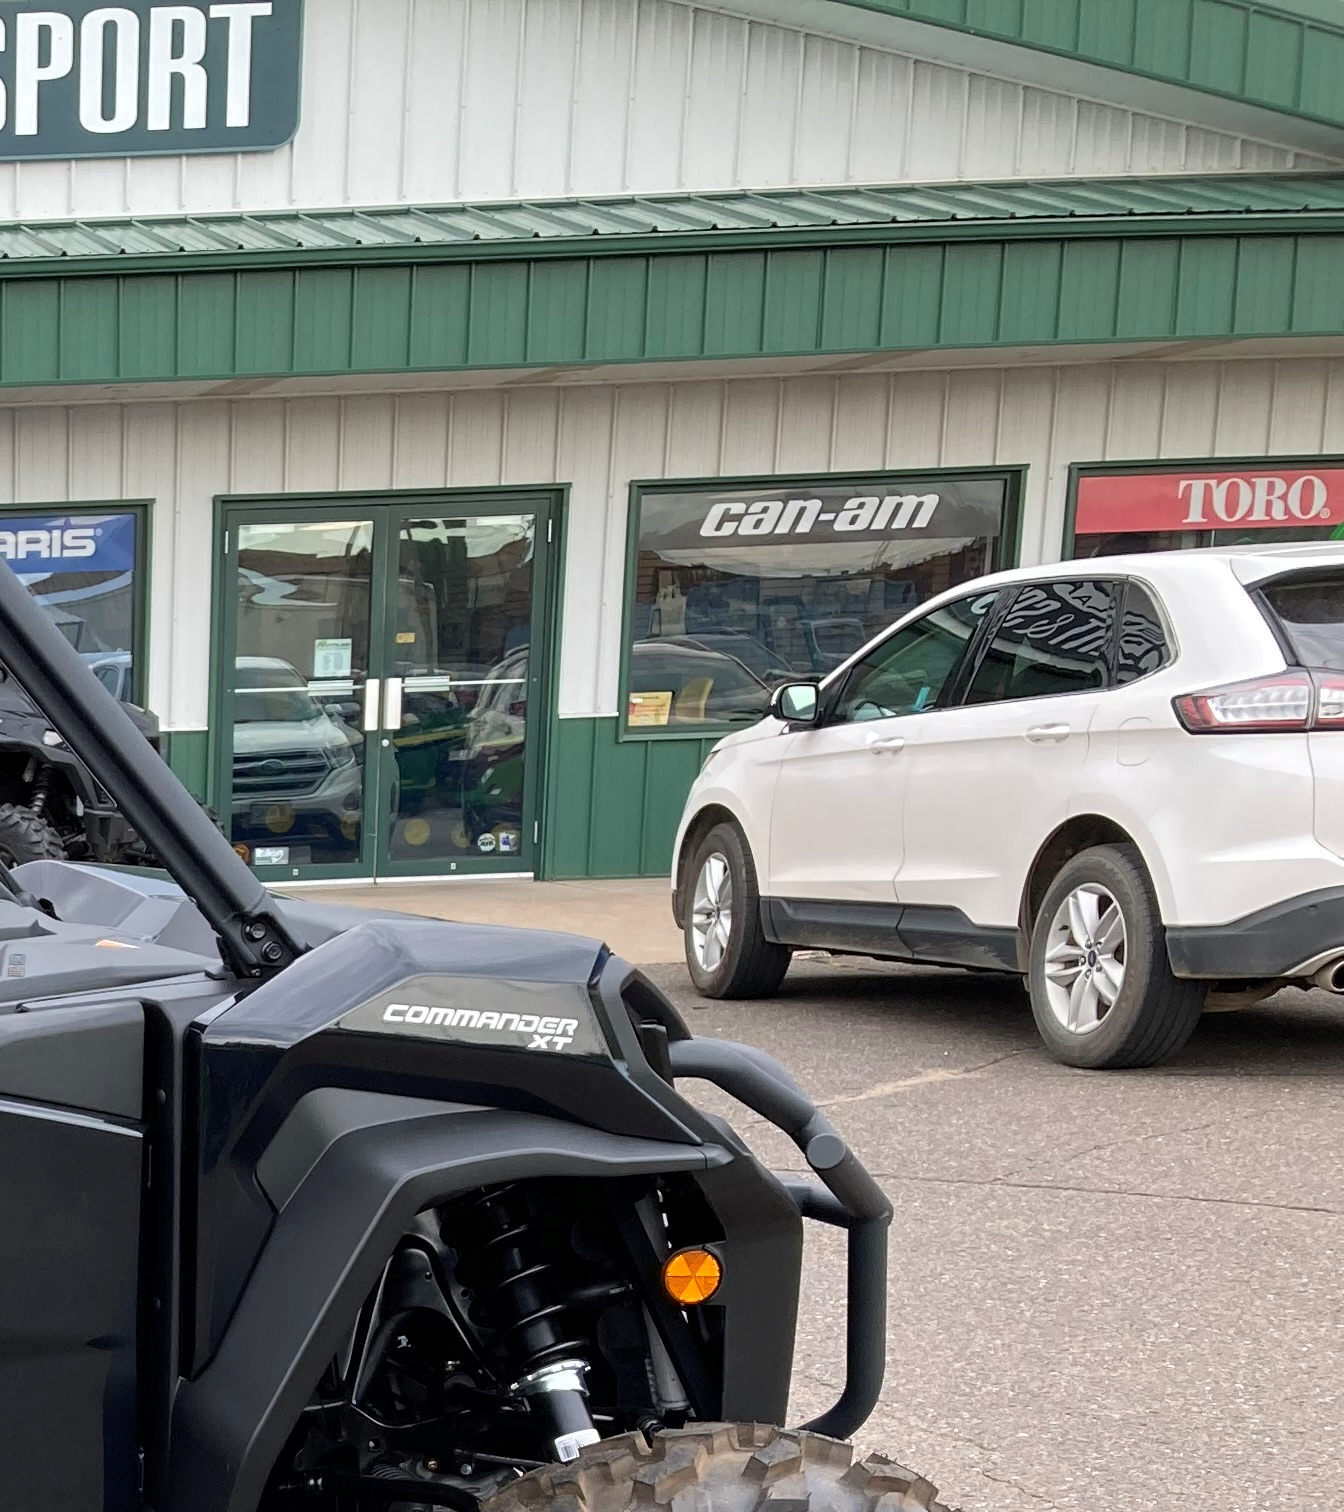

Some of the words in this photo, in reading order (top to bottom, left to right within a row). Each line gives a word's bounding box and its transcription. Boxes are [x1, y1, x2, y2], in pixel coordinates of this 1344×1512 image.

[699, 492, 940, 538] can-am
[1178, 476, 1327, 523] TORO
[382, 1003, 578, 1035] COMMANDER
[528, 1033, 574, 1051] XT
